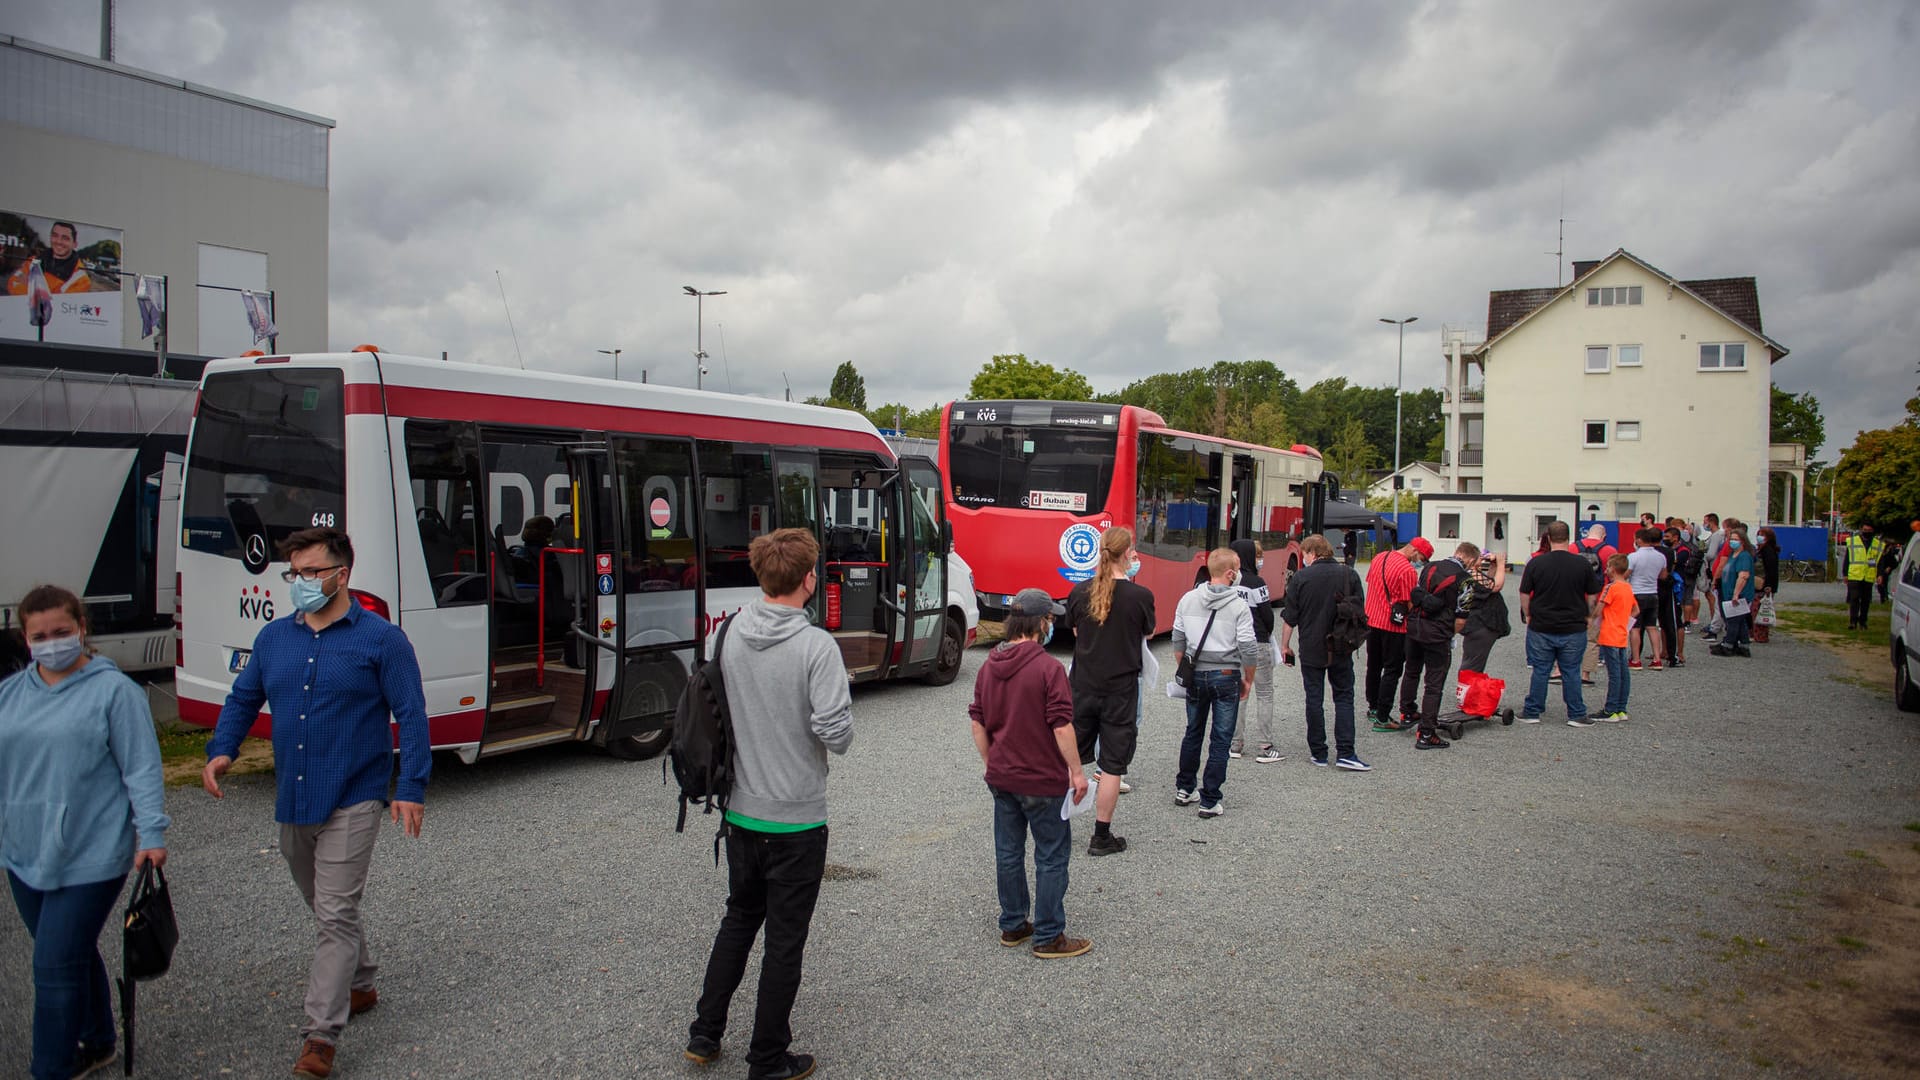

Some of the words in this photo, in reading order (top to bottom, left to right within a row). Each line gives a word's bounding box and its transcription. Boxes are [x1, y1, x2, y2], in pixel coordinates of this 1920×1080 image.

[977, 411, 997, 422] KVG
[1043, 496, 1070, 504] dubau
[1074, 495, 1085, 504] 50
[311, 513, 335, 528] 648
[1099, 520, 1112, 528] 411
[240, 597, 275, 622] KVG
